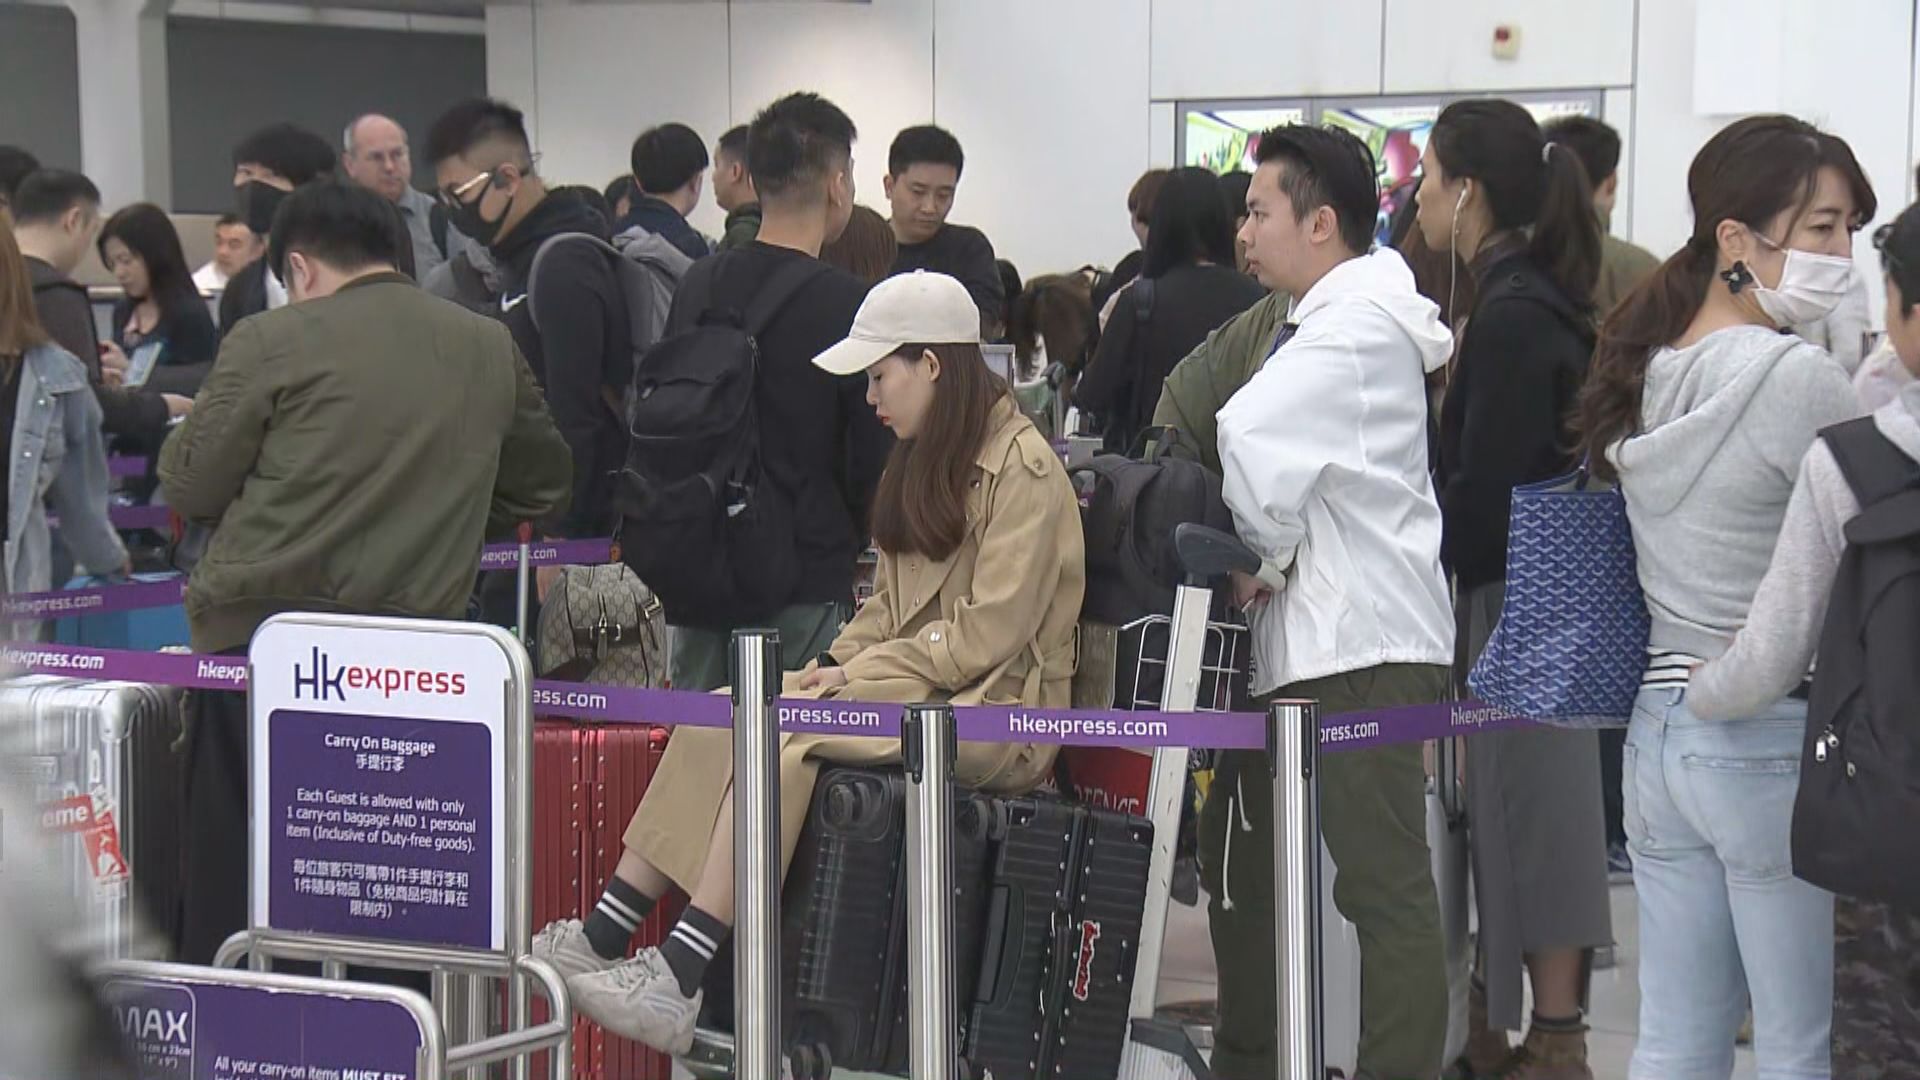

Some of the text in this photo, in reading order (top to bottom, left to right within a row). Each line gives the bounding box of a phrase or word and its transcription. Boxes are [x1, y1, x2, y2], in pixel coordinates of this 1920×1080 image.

[1009, 713, 1168, 739] hkexpress.com
[324, 733, 435, 757] Carry On Baggage
[355, 753, 405, 772] 手提行李
[297, 788, 465, 817] Each Guest is allowed with only
[287, 806, 476, 834] 1 carry-on baggage AND 1 personal
[286, 823, 475, 854] item (Inclusive of Duty-free goods).
[214, 1055, 229, 1071] All
[231, 1059, 257, 1075] your
[259, 1062, 305, 1079] carry-on
[308, 1064, 340, 1080] items
[342, 1067, 381, 1080] MUST
